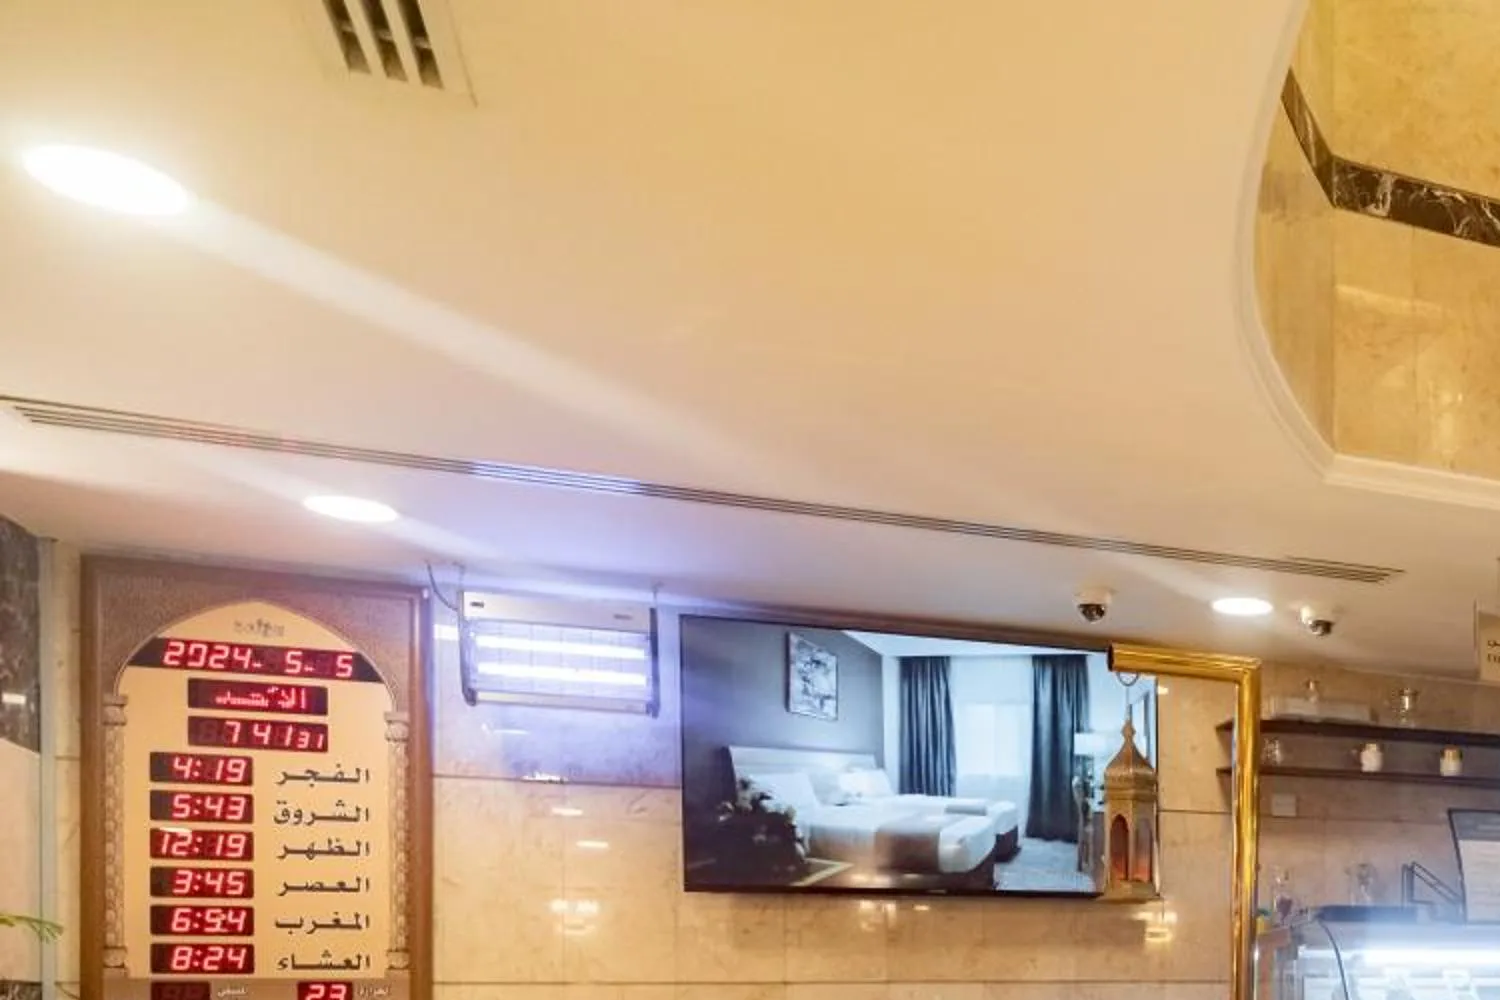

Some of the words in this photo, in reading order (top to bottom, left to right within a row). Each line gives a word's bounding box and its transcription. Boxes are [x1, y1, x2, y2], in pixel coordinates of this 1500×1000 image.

[173, 756, 246, 783] 4:19
[275, 763, 370, 788] الفجر
[172, 793, 246, 820] 5:43
[273, 799, 370, 826] الشروق
[160, 830, 246, 857] 12:19
[275, 837, 370, 861] الظهر
[172, 869, 245, 896] 3:45
[277, 875, 370, 897] العصر
[274, 911, 370, 935] المغرب
[171, 945, 247, 971] 8:24
[277, 949, 371, 971] العشاء
